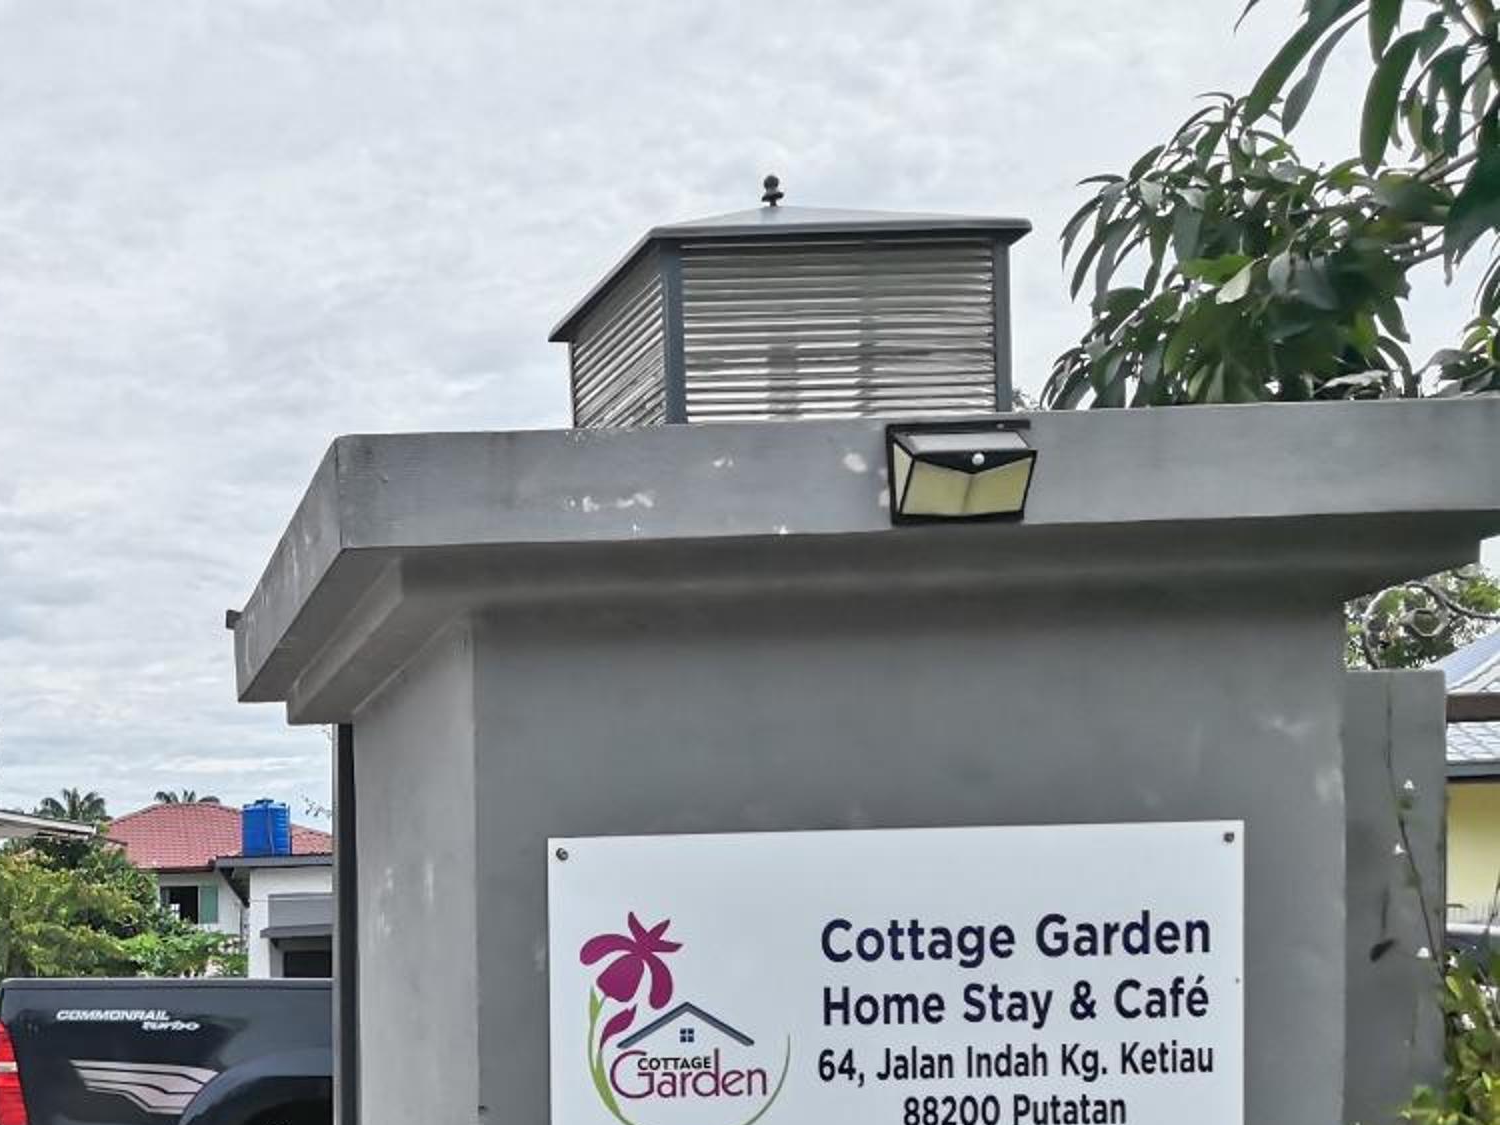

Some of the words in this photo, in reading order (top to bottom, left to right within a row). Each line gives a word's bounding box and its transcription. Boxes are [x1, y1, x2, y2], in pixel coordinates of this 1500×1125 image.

[821, 918, 1016, 969] Cottage
[1035, 909, 1211, 958] Garden
[55, 1009, 171, 1022] COMMONRAIL
[823, 986, 946, 1027] Home
[963, 982, 1053, 1030] Stay
[1069, 979, 1097, 1021] &
[1114, 974, 1209, 1020] Café
[610, 1047, 768, 1099] Garden
[637, 1056, 712, 1071] COTTAGE
[817, 1048, 865, 1088] 64,
[876, 1045, 954, 1081] Jalan
[967, 1042, 1048, 1079] Indah
[1061, 1043, 1108, 1083] Kg.
[1120, 1039, 1214, 1075] Ketiau
